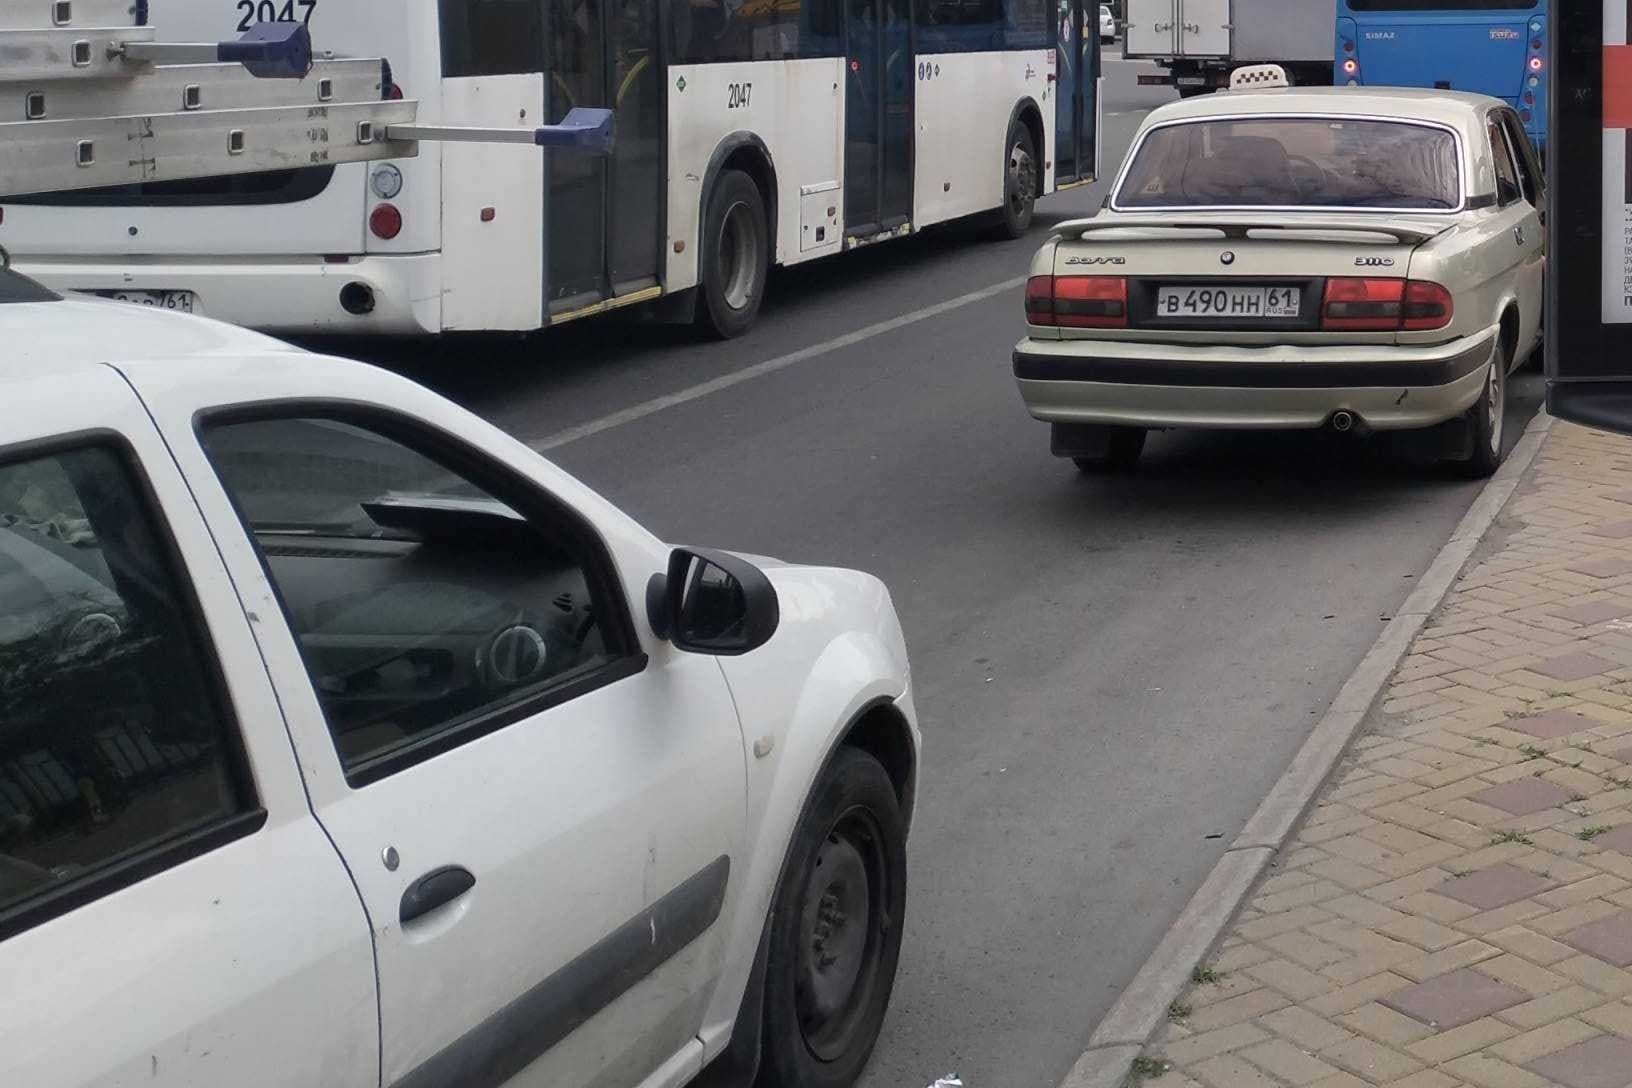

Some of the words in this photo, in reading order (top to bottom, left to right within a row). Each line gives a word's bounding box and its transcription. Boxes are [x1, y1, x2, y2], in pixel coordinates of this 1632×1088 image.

[236, 0, 317, 32] 2047
[728, 83, 752, 109] 2047
[1267, 289, 1292, 307] 61
